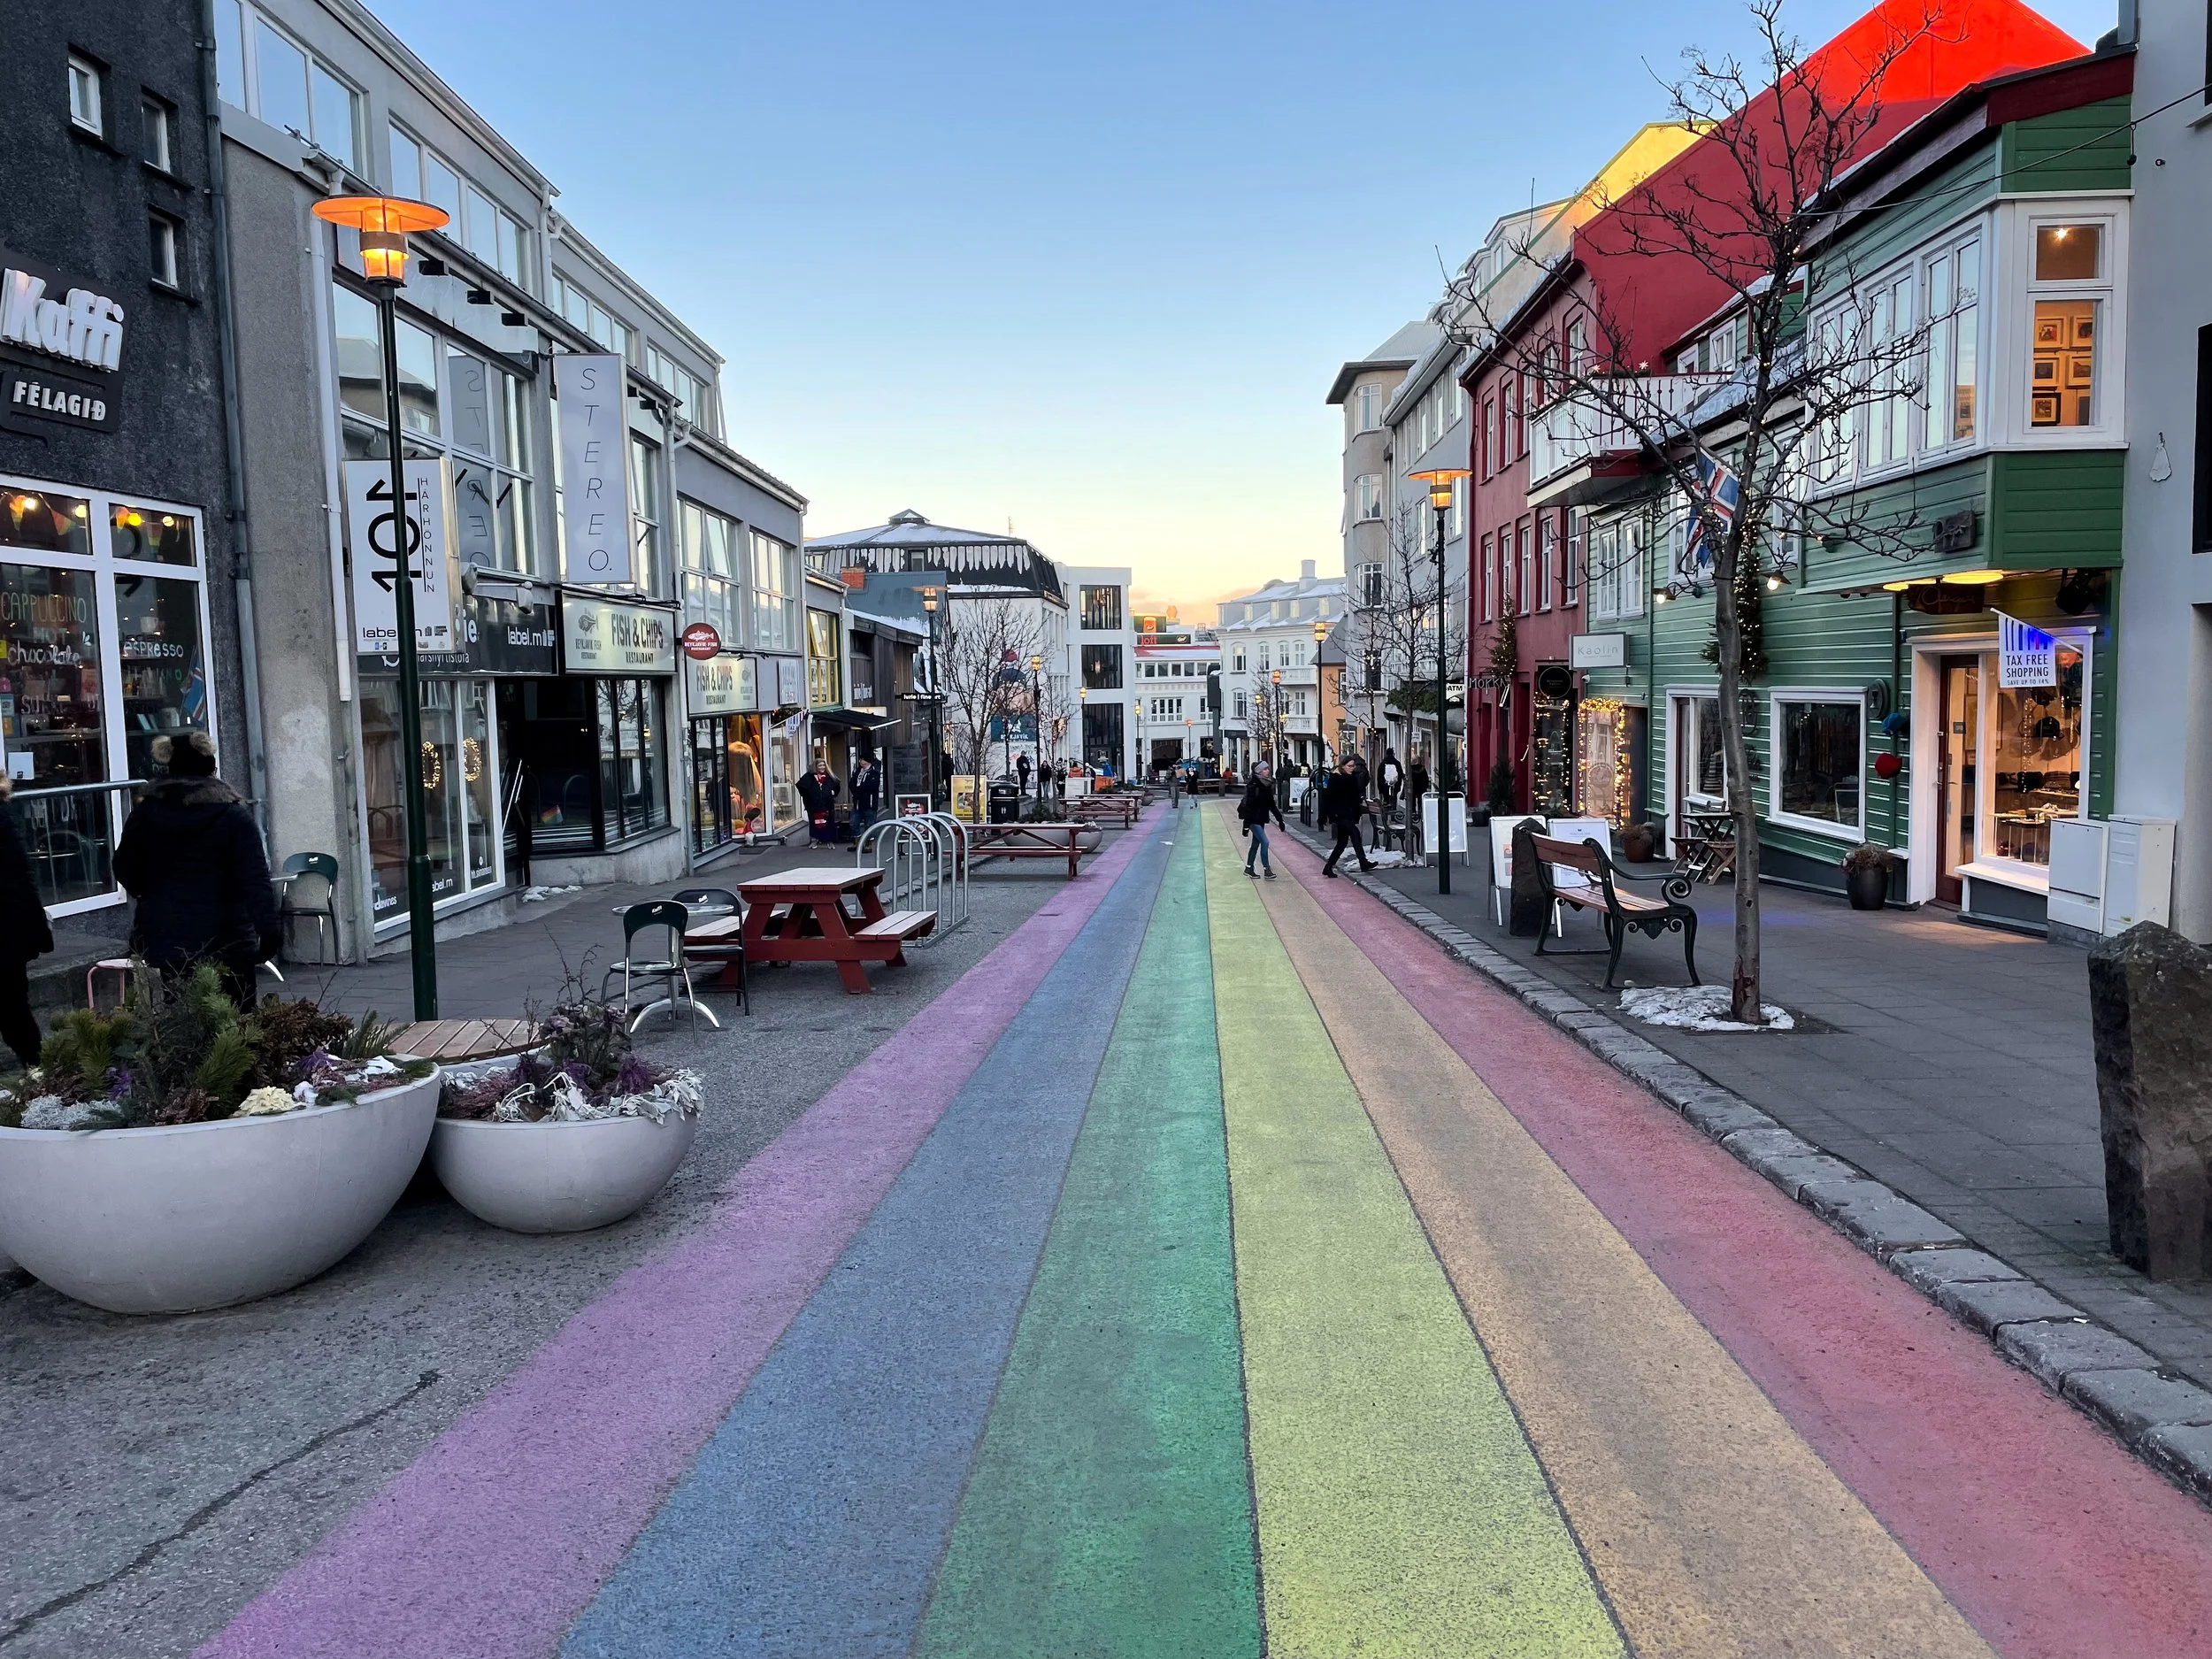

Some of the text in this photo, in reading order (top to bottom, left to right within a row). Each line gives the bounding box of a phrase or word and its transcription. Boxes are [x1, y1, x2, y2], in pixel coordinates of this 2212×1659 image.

[1, 268, 124, 373] Kaffi
[12, 380, 106, 421] FÉLAGIÐ
[1, 592, 87, 623] CAPPUCCINO
[507, 626, 542, 646] label.m
[611, 613, 664, 649] FISH & CHIPS
[1141, 634, 1157, 645] loft
[7, 639, 81, 666] chocolate
[626, 651, 654, 665] RESTAURANT
[1578, 644, 1618, 655] Kaolin
[2006, 654, 2048, 665] TAX FREE
[695, 664, 733, 692] FISH & CHIPS
[2006, 667, 2049, 678] SHOPPING
